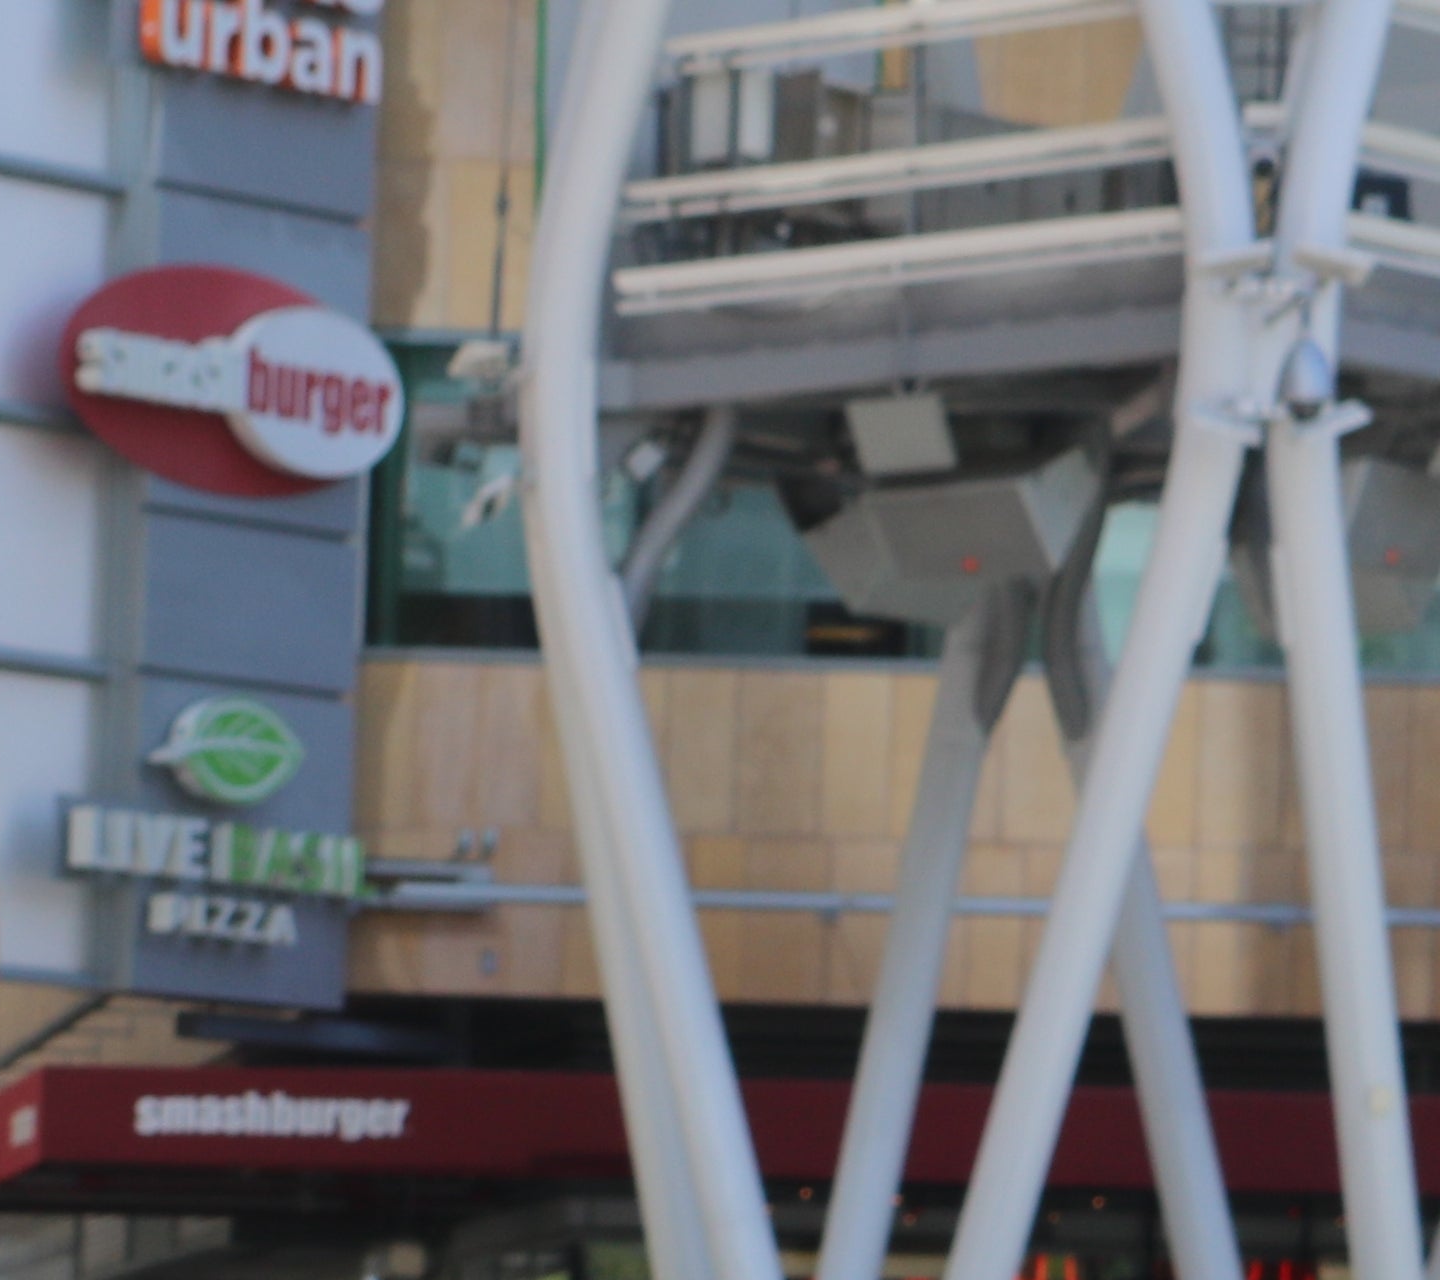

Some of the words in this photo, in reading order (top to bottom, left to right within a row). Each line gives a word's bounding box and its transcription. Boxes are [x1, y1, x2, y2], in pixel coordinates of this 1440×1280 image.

[158, 0, 383, 106] urban
[247, 344, 394, 437] burger
[66, 804, 210, 881] LIVE
[147, 892, 298, 945] PIZZA
[133, 1090, 412, 1141] smashburger
